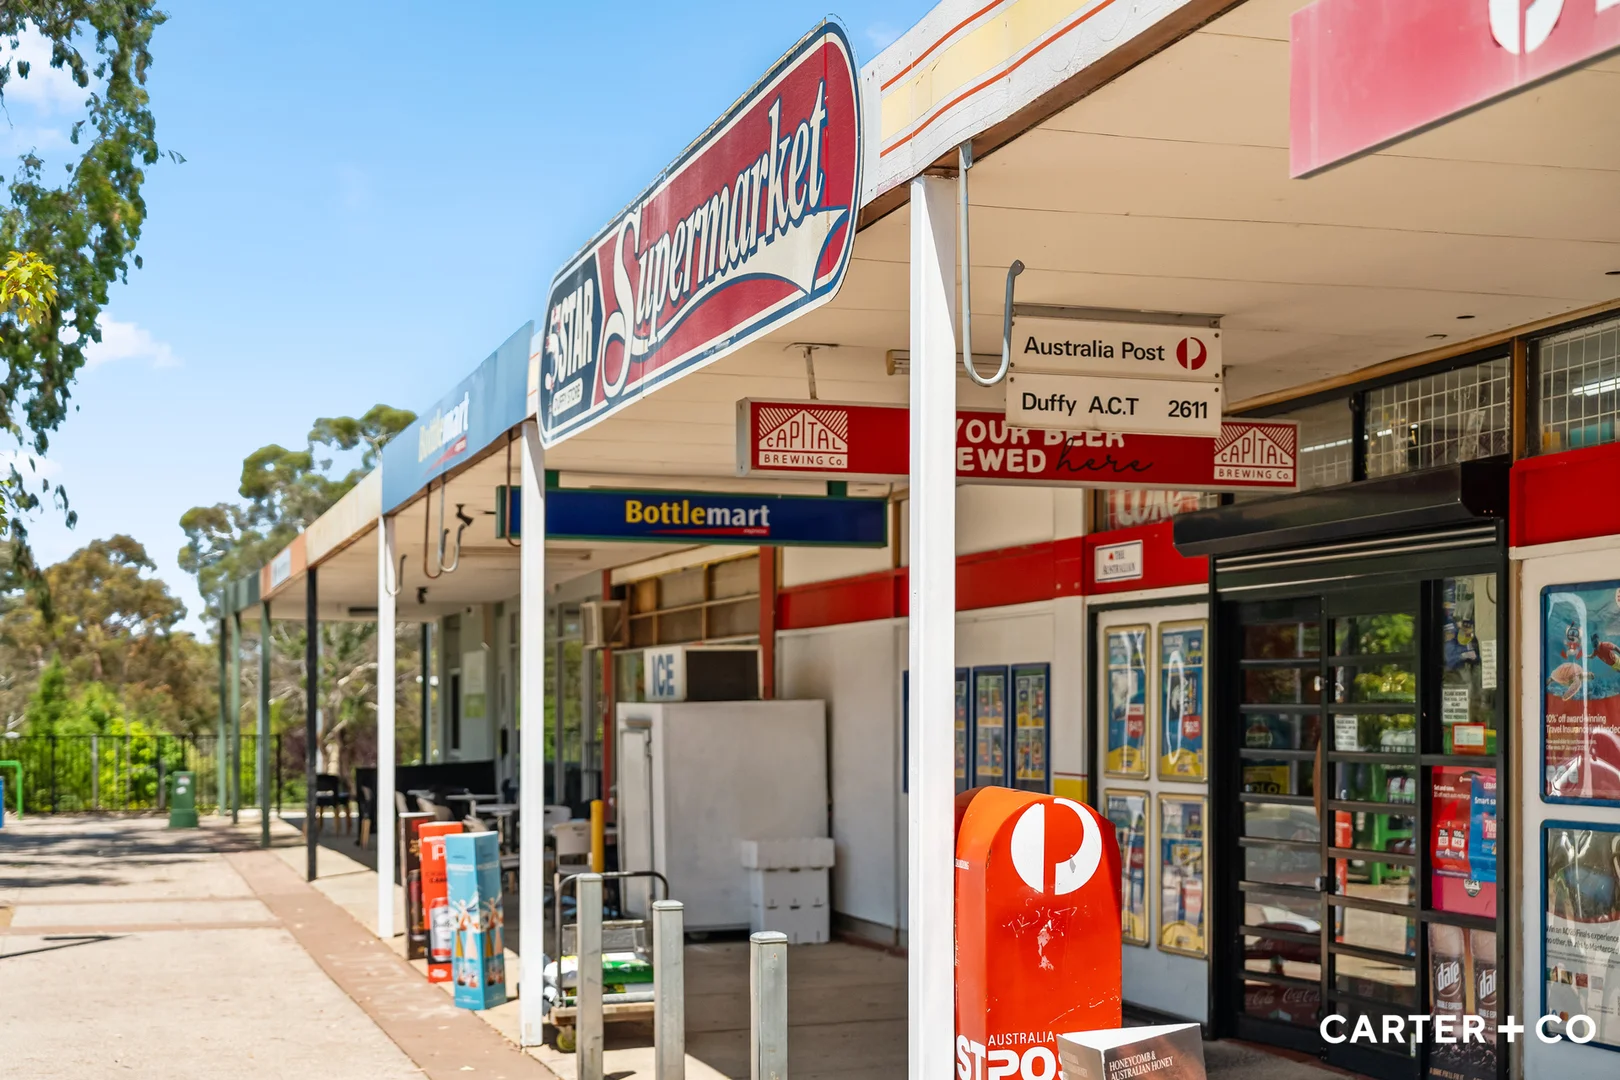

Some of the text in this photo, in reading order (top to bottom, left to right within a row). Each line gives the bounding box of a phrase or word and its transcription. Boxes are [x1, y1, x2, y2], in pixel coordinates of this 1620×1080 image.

[602, 78, 827, 398] Supermarket
[1024, 336, 1165, 361] Australia Post
[1022, 392, 1208, 419] Duffy A.C.T 2611
[767, 412, 841, 450] CAPITAL
[764, 454, 845, 466] BREWING Co.
[1055, 437, 1154, 472] here
[1221, 430, 1288, 465] CAPITAL
[1219, 468, 1272, 479] BREWING
[625, 499, 770, 526] Bottlemart
[652, 654, 675, 697] ICE
[1437, 961, 1460, 991] dare
[987, 1031, 1055, 1046] AUSTRALIA
[988, 1046, 1063, 1080] PO
[1109, 1050, 1157, 1072] HONEYCOMB &
[1111, 1056, 1173, 1080] AUSTRALIAN HONEY
